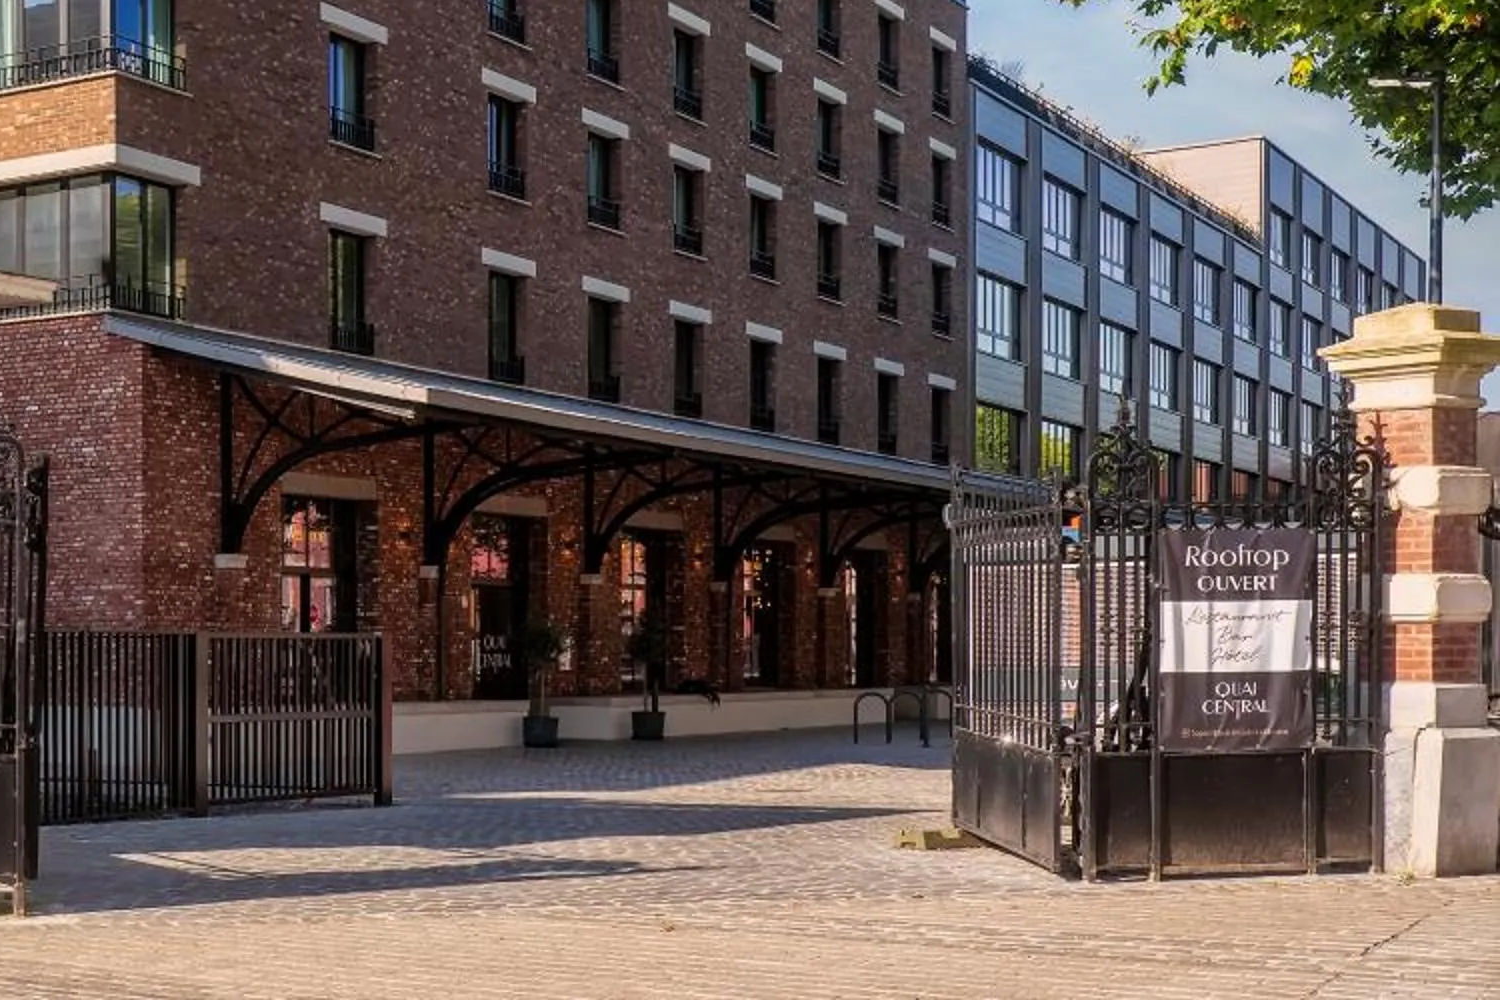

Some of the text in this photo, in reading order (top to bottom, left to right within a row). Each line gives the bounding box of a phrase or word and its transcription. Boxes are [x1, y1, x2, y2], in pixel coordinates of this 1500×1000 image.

[1185, 543, 1290, 571] Rooftop
[1197, 574, 1279, 592] OUVERT
[1215, 681, 1257, 699] QUAI
[1202, 699, 1271, 720] CENTRAL
